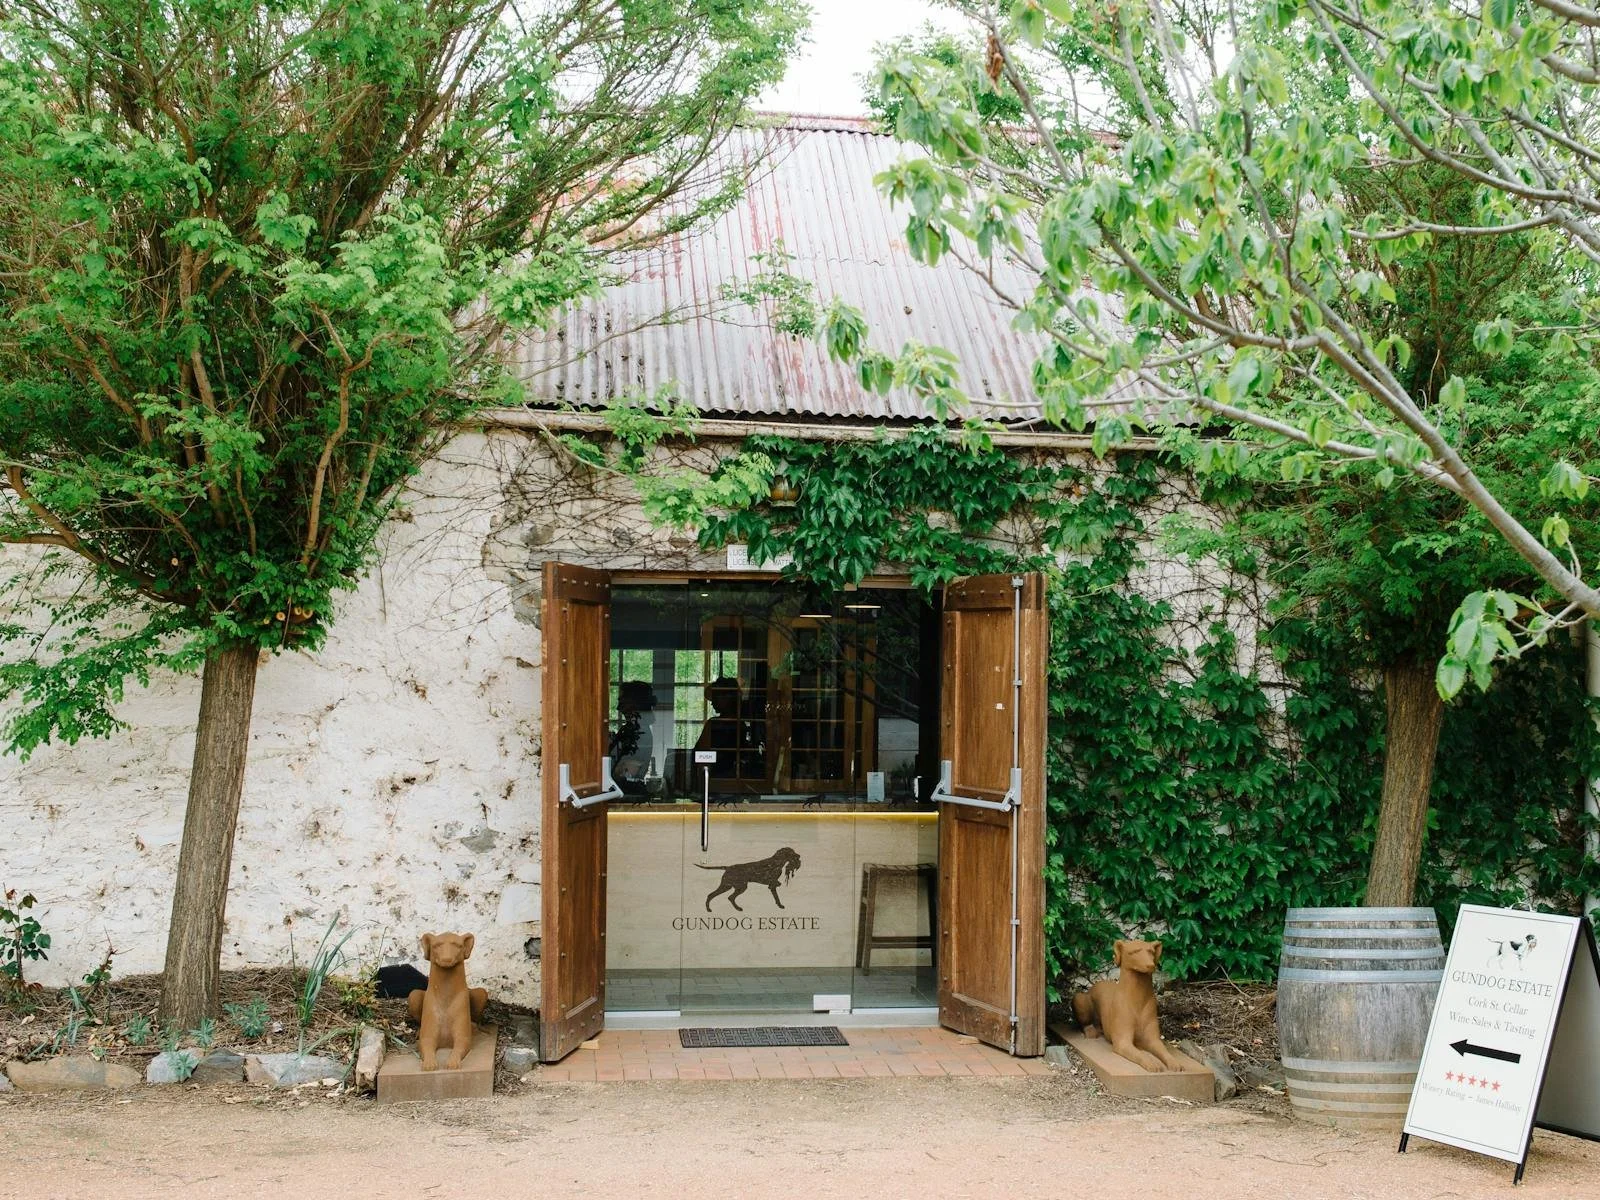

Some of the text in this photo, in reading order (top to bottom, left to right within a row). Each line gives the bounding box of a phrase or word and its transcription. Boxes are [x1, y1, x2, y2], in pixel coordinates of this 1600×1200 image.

[672, 916, 820, 931] GUNDOG ESTATE
[1452, 970, 1552, 997] GUNDOG ESTATE
[1468, 996, 1528, 1016] Cork St. Cellar
[1449, 1011, 1536, 1039] Wine Sales & Tasting
[1445, 1087, 1466, 1100] Rating
